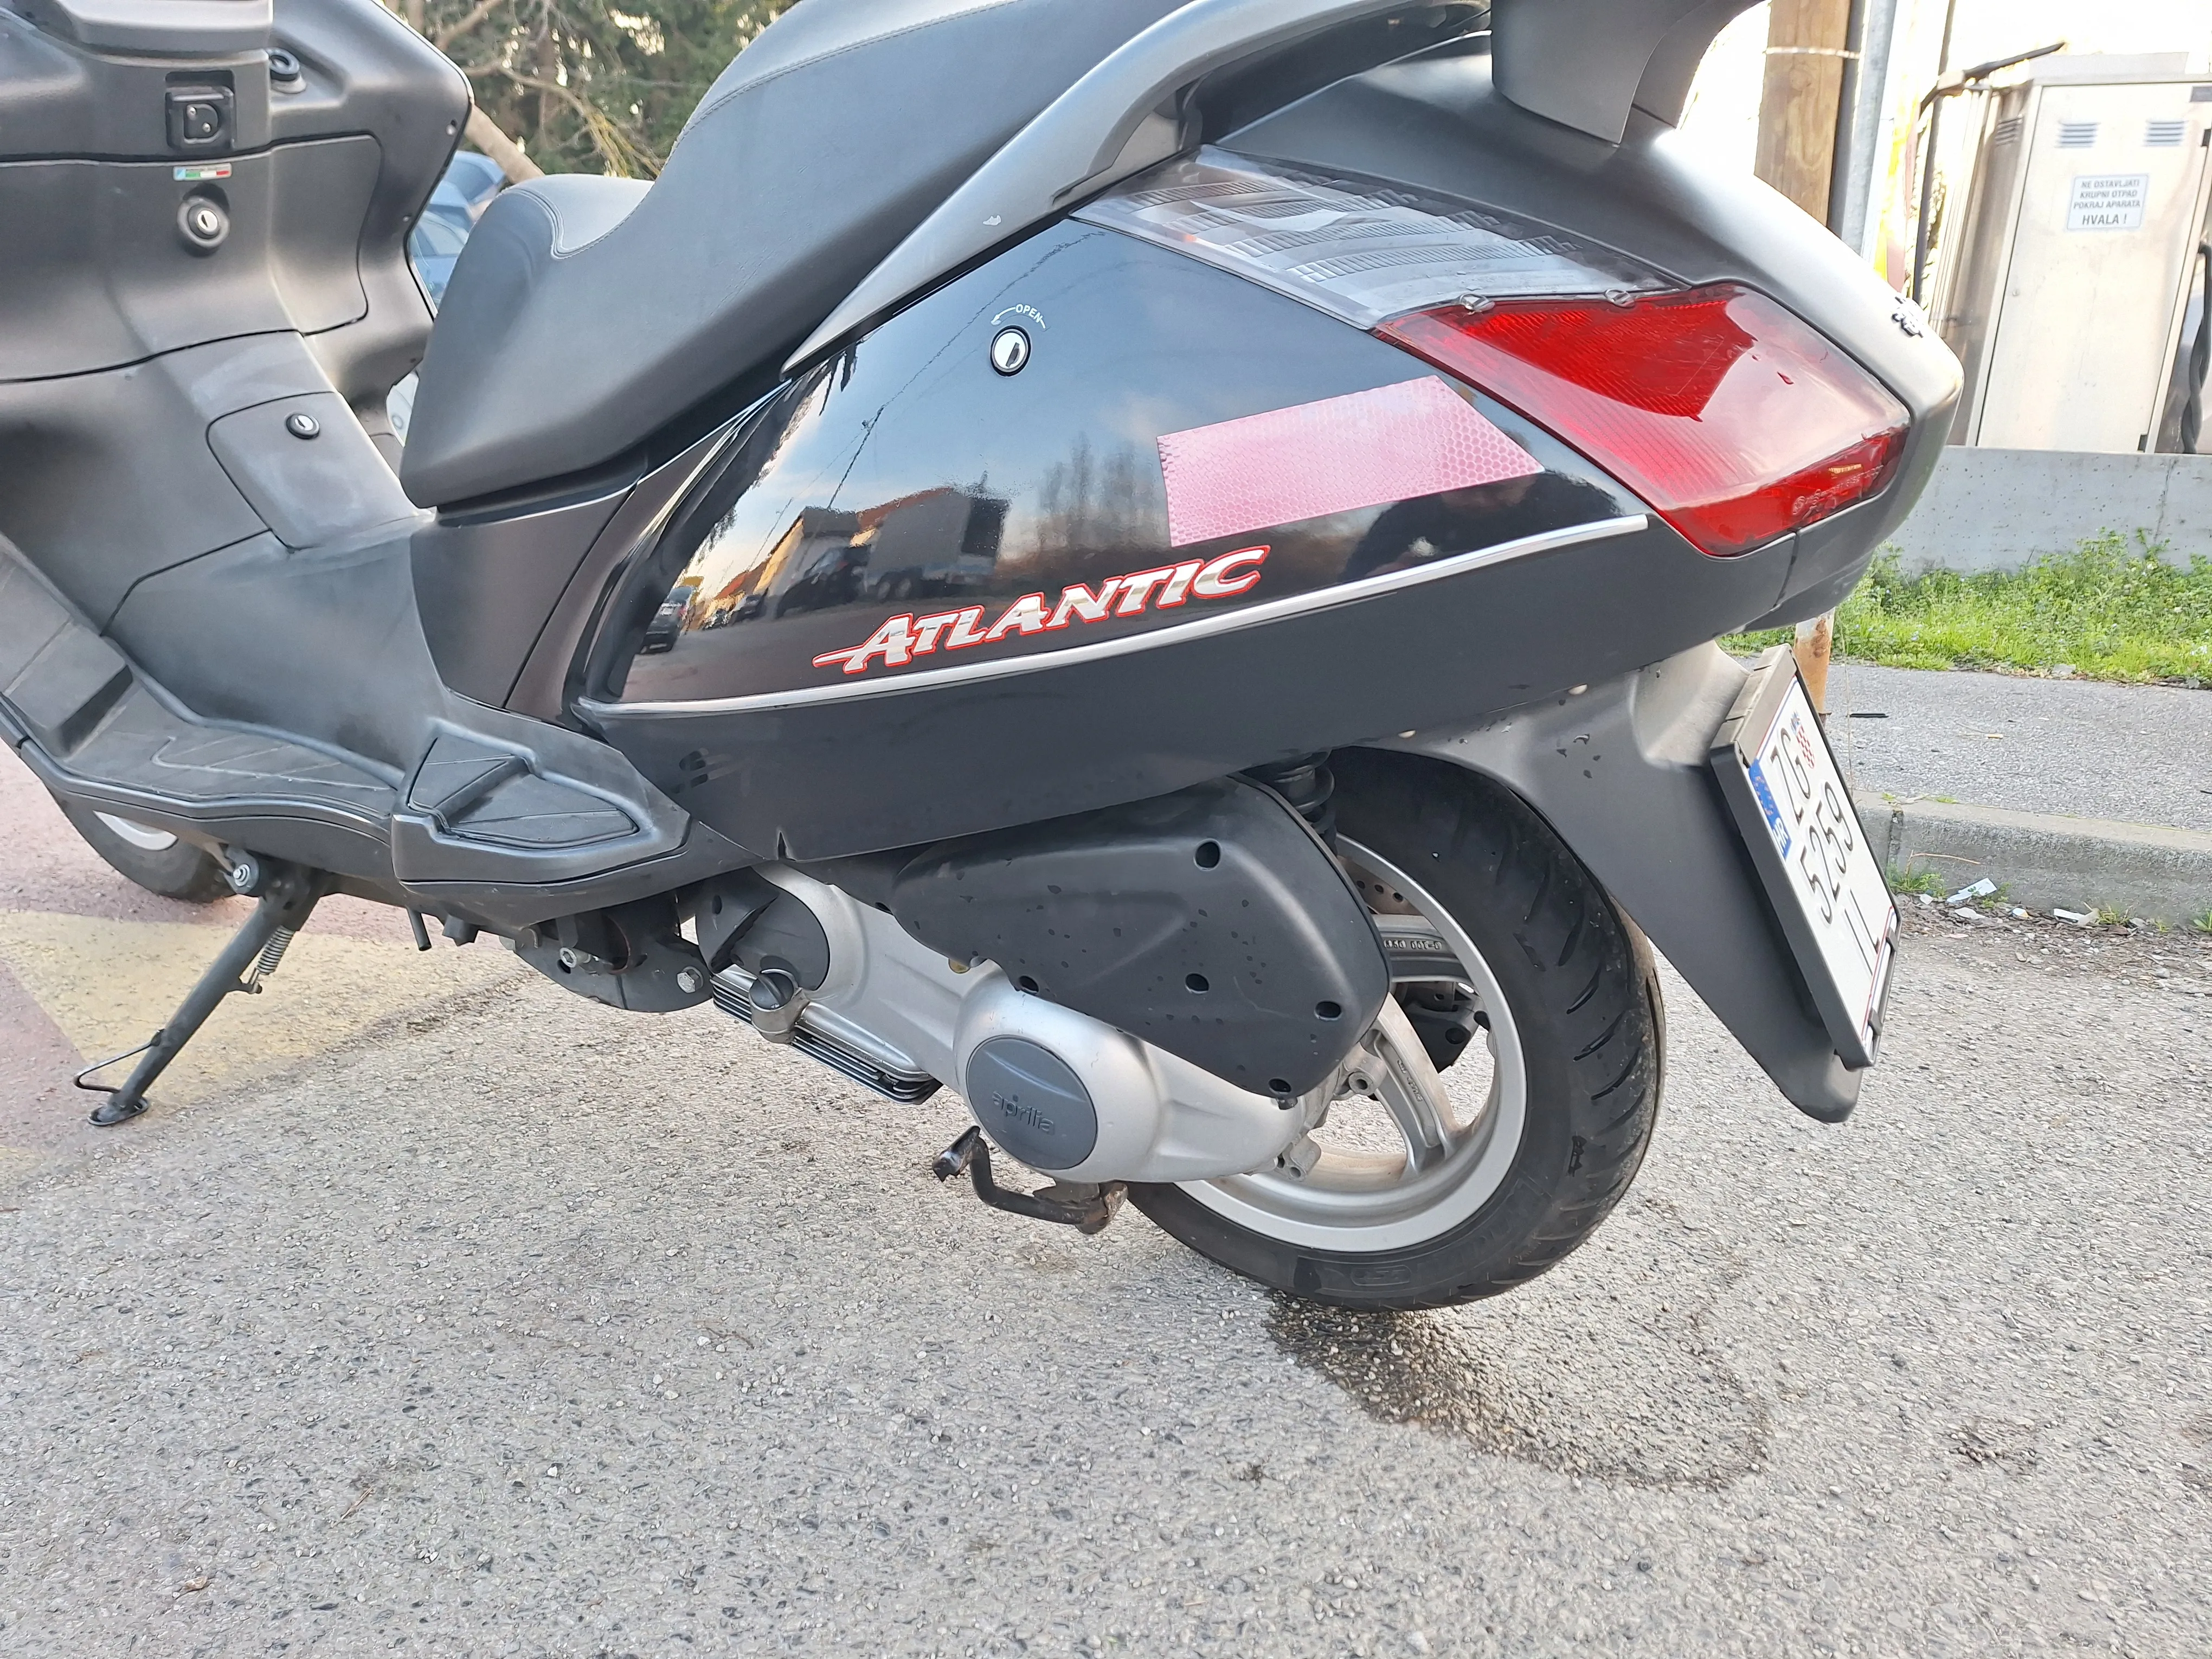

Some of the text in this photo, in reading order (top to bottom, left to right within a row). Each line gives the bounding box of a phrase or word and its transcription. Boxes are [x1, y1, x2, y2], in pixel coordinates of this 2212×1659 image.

[2080, 189, 2138, 199] KRUPNI OTPAD
[2081, 179, 2140, 189] NE OSTAVLJATI
[2073, 200, 2140, 209] POKRAJ APARATA
[2082, 214, 2119, 225] HVALA
[1015, 304, 1043, 323] OPEN
[812, 545, 1271, 674] ATLANTIC
[1770, 726, 1811, 826] ZG
[1771, 816, 1789, 853] HR
[1799, 781, 1854, 925] 5259
[1844, 888, 1880, 976] IL
[992, 1091, 1055, 1135] aprilia
